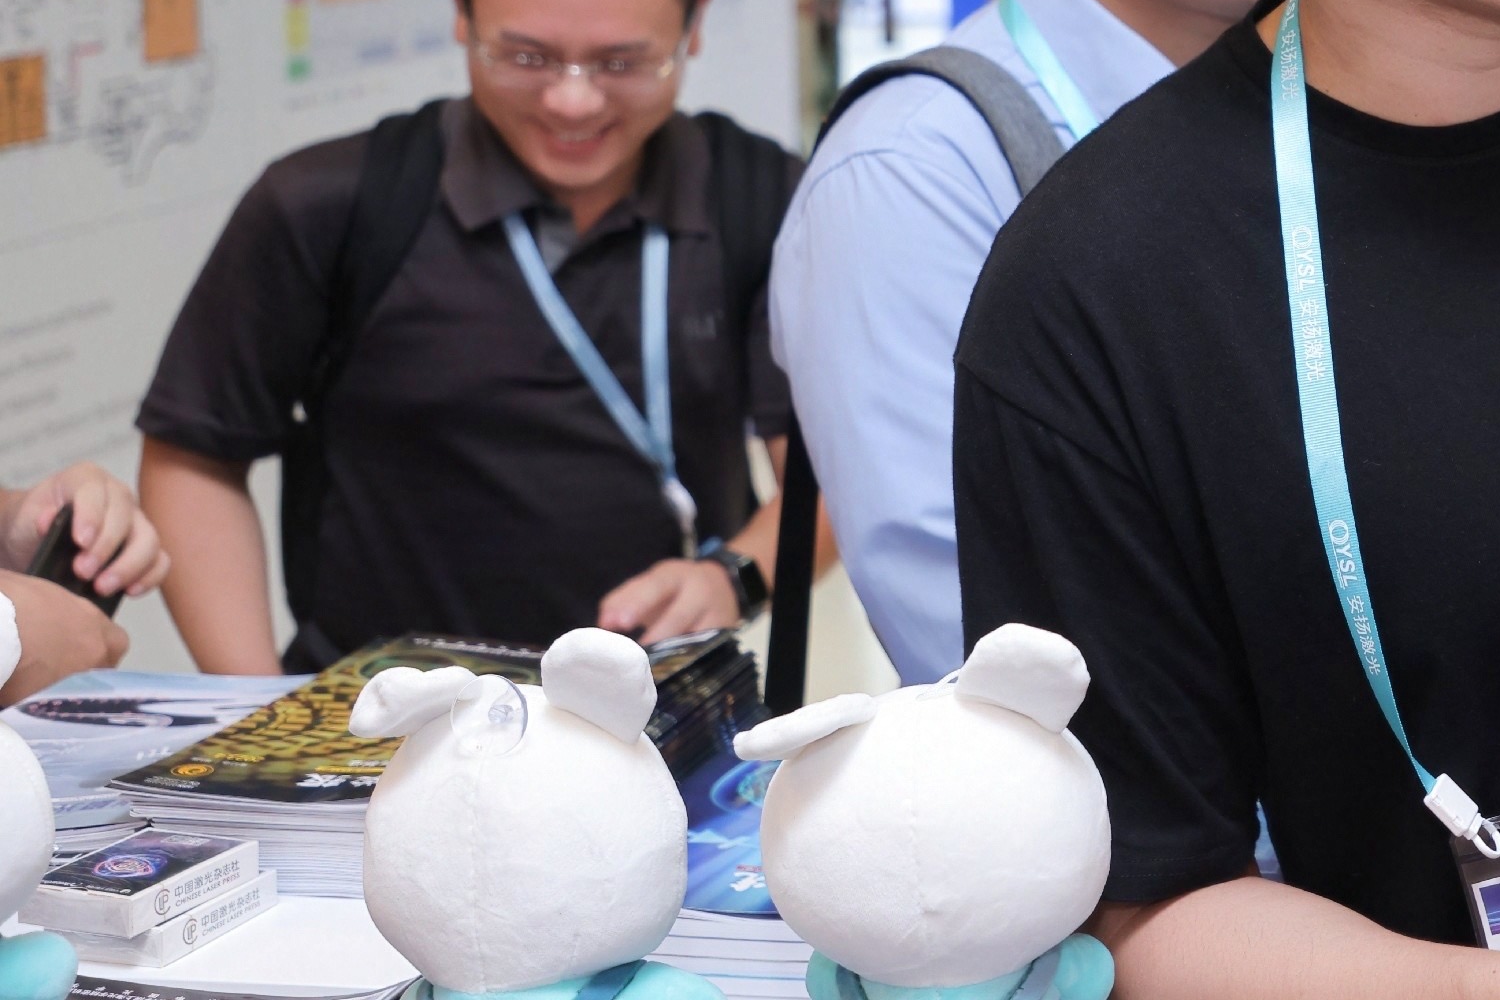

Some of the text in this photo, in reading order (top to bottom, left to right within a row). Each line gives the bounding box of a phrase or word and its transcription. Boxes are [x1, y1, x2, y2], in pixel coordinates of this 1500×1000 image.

[1347, 595, 1381, 676] 安扬激光
[174, 859, 240, 898] 中国激光杂志社
[175, 890, 201, 908] CHINESE
[203, 881, 221, 895] LASER
